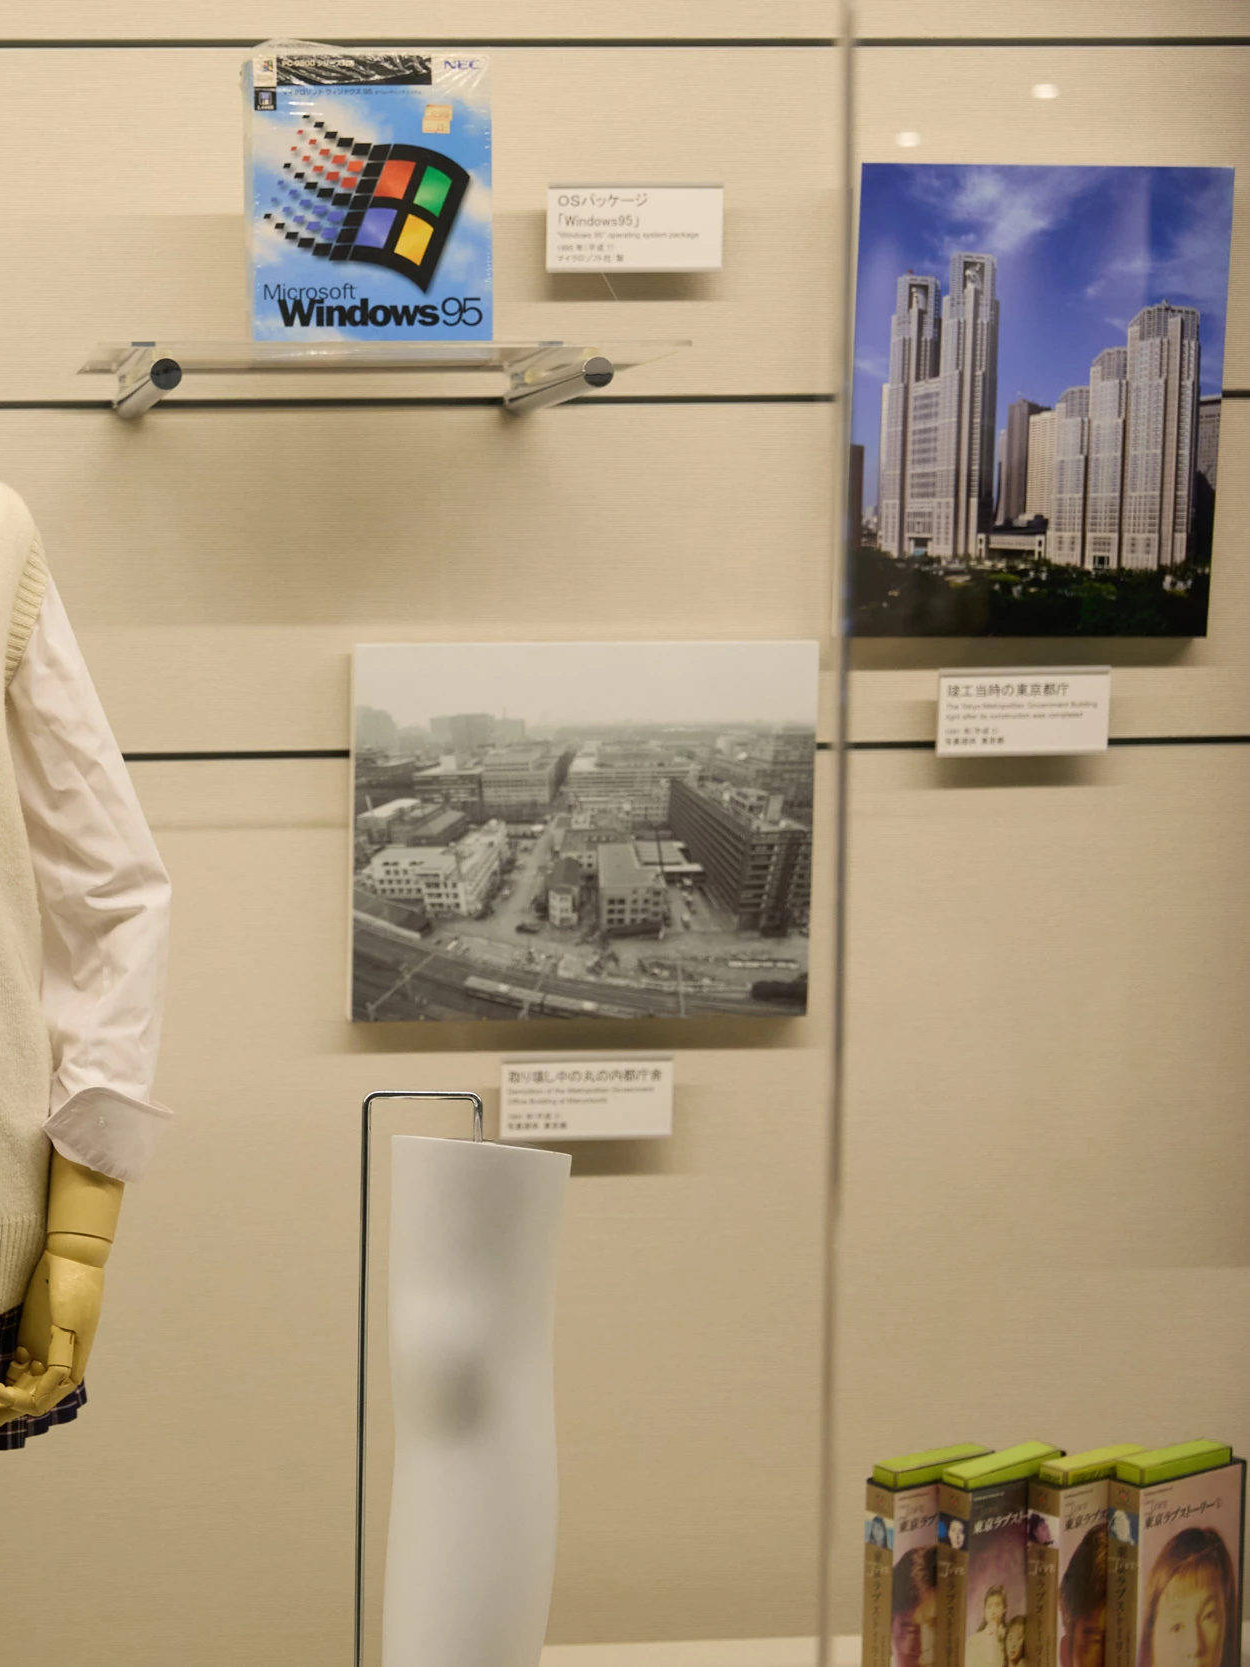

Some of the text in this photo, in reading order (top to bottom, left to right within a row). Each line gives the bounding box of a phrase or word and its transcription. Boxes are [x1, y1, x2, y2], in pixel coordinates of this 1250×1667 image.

[443, 60, 481, 70] NEC
[557, 193, 648, 208] OSパッケージ
[558, 213, 640, 228] 「Windows95」
[263, 283, 357, 300] Microsoft
[278, 297, 483, 327] Windows 95
[947, 683, 1069, 698] 竣工当時の東京都庁
